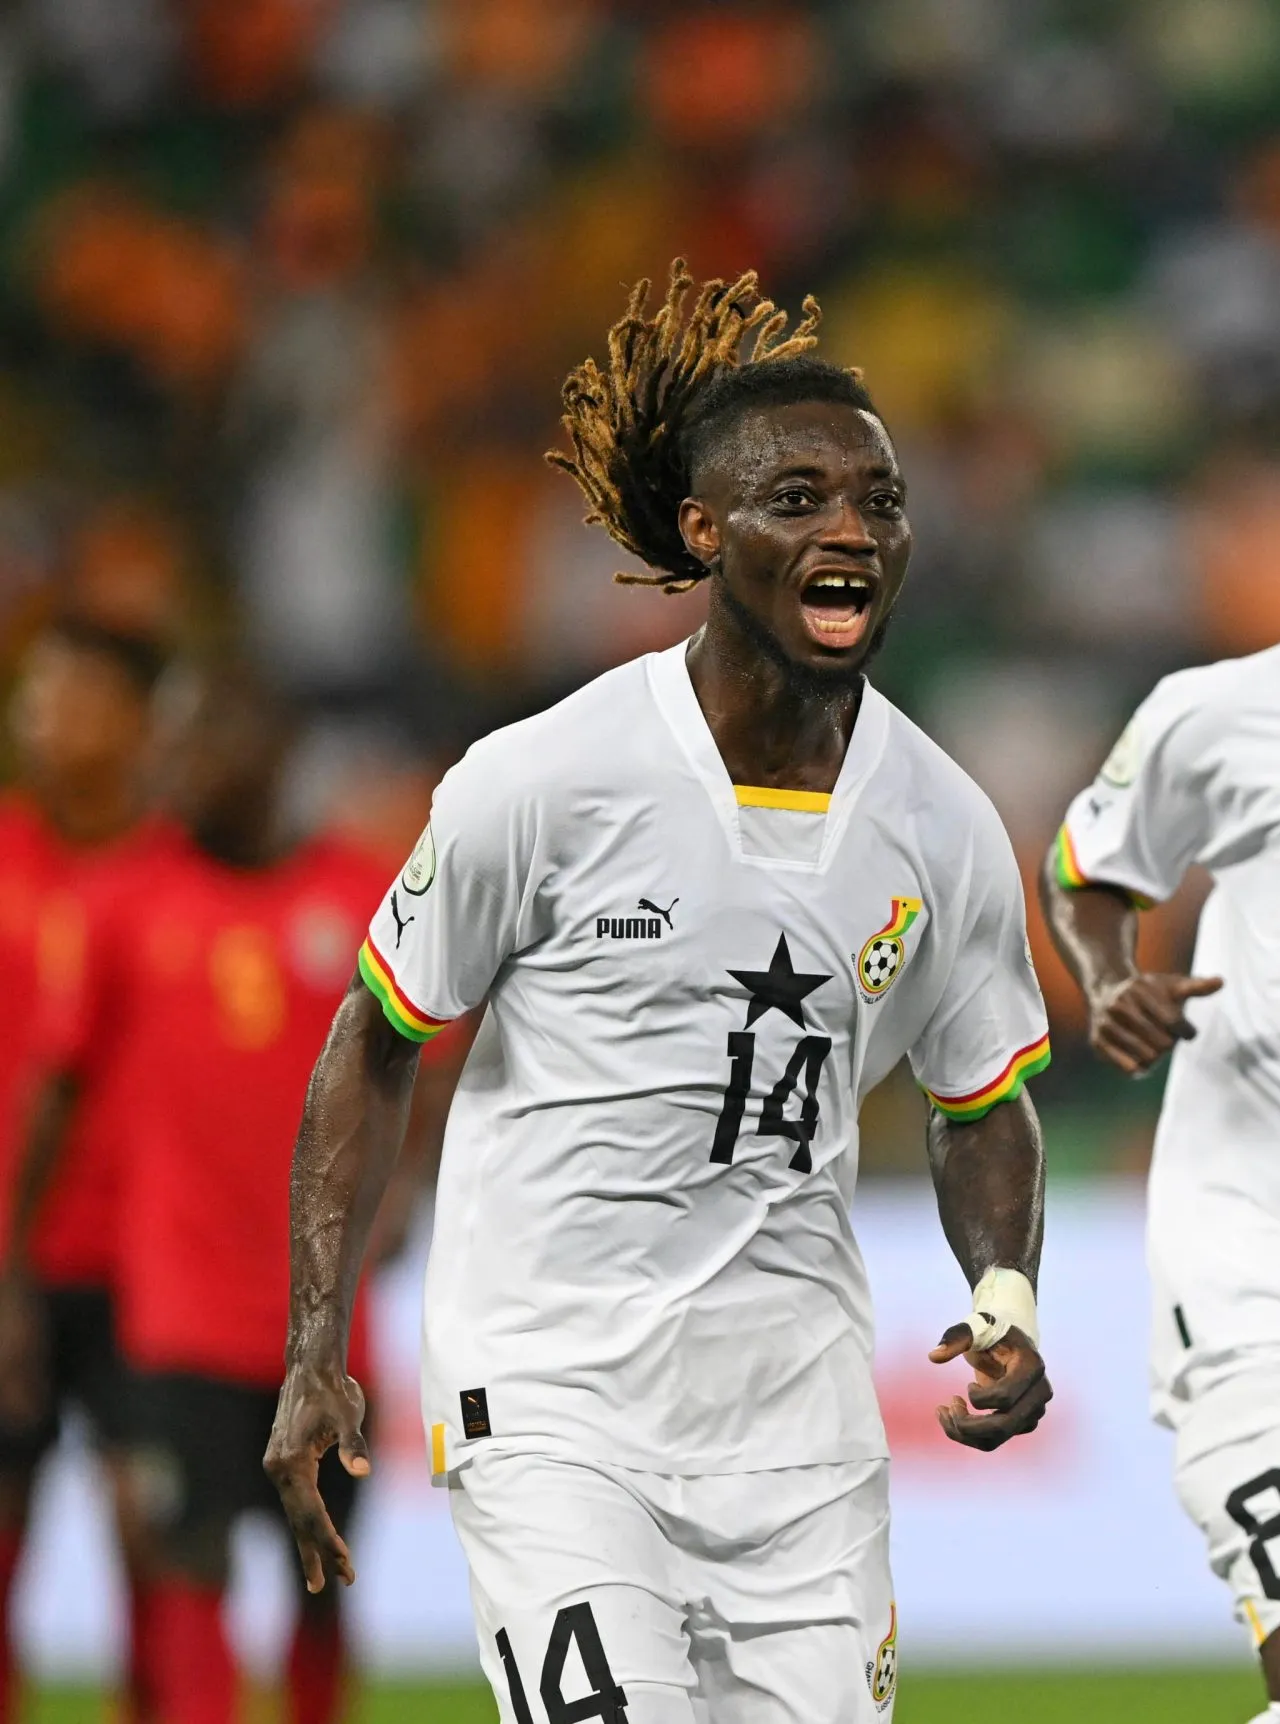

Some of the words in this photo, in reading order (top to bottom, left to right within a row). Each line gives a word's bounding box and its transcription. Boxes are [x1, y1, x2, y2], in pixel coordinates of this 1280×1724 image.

[597, 918, 661, 939] PUMA
[709, 1031, 832, 1175] 14
[495, 1601, 629, 1724] 14
